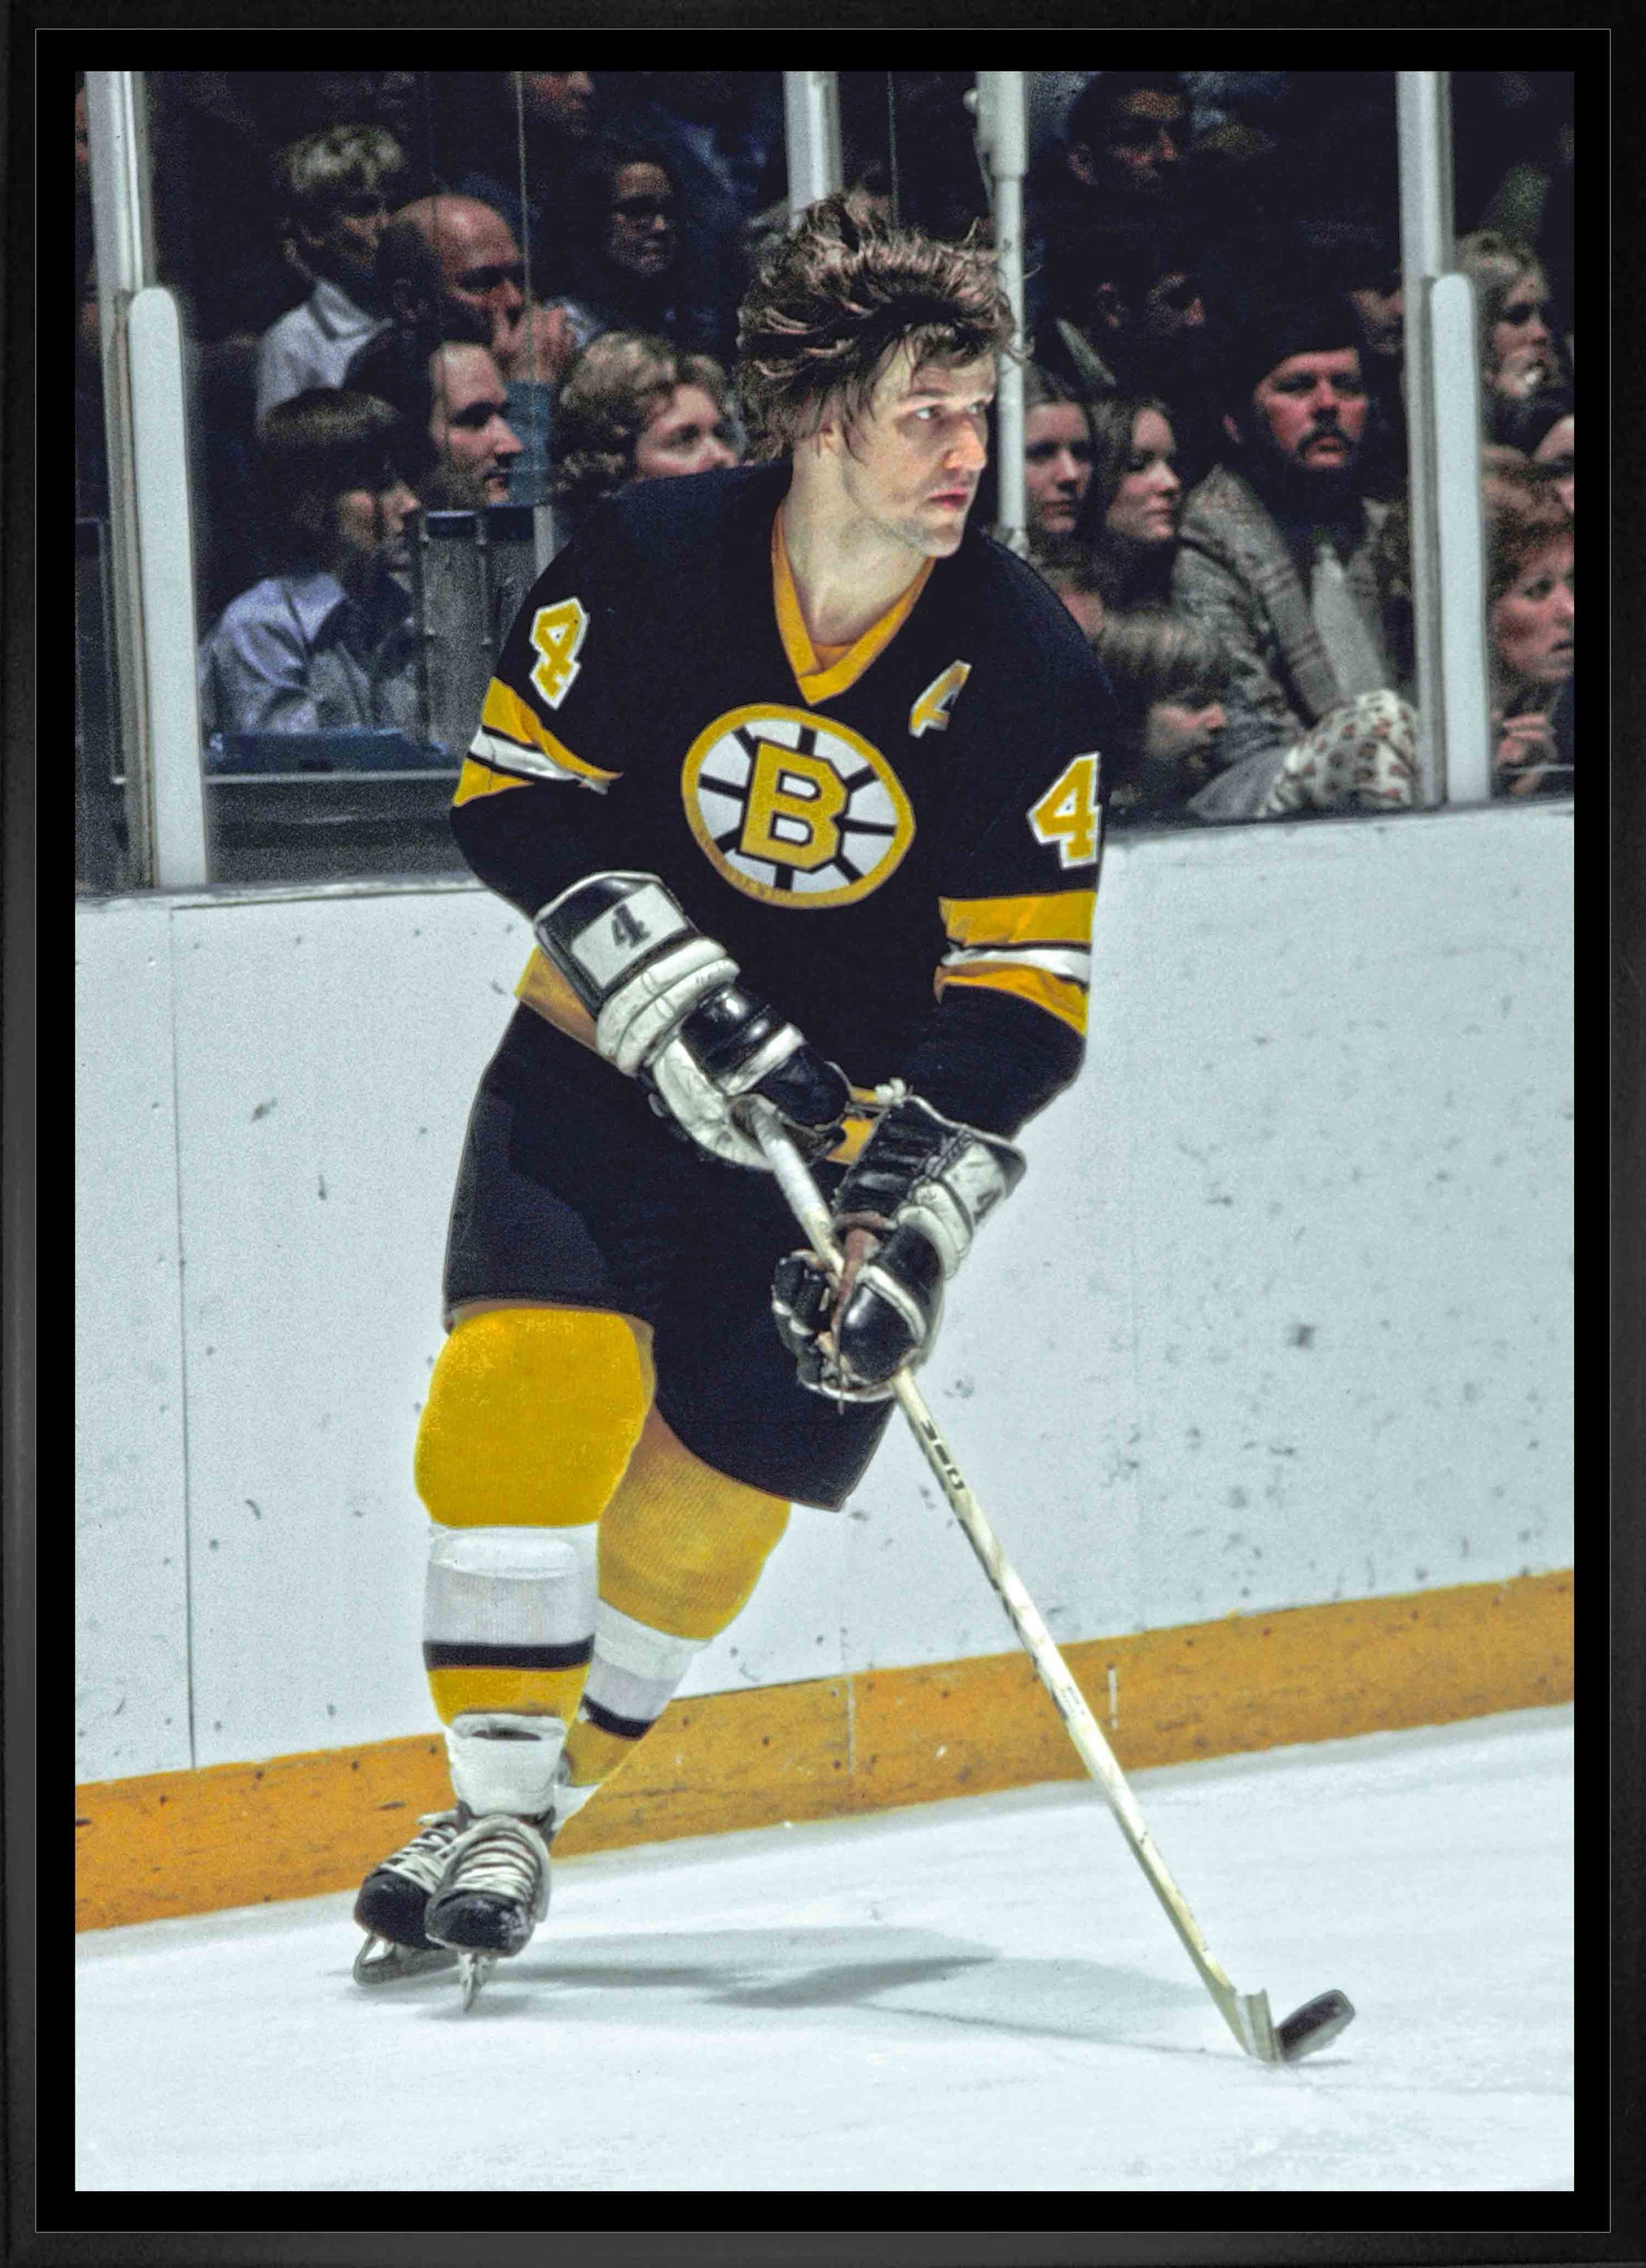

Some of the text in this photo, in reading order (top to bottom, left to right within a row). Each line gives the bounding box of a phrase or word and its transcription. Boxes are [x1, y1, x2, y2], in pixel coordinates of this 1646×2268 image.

[530, 597, 590, 710] 4
[738, 736, 849, 872] B
[1027, 751, 1101, 869] 4
[611, 903, 651, 948] 4
